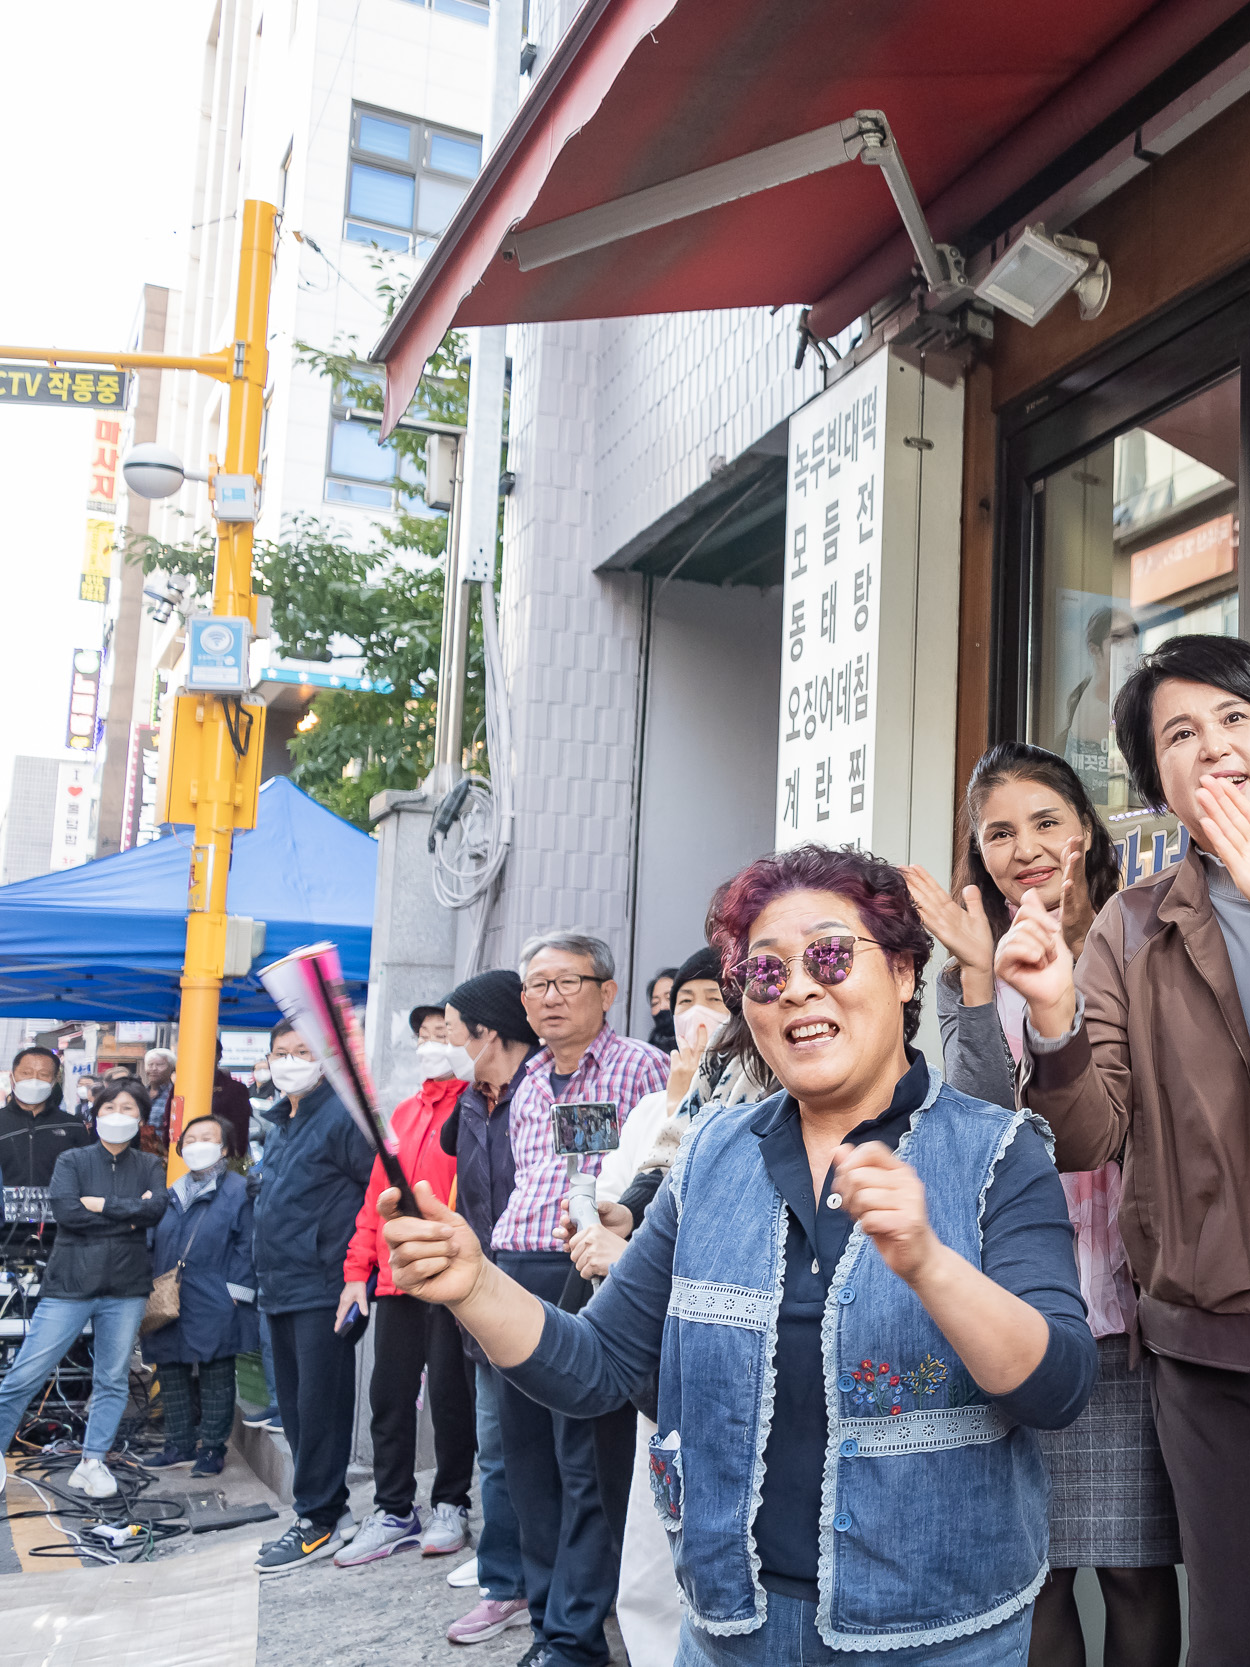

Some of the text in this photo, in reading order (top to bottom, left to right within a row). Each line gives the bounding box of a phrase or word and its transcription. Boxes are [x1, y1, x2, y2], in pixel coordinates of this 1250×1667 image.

[47, 371, 120, 404] 작동중
[91, 420, 121, 499] 마사지
[794, 384, 878, 498] 녹두빈대떡
[791, 474, 875, 581] 모듬전
[788, 562, 872, 663] 동태탕
[785, 652, 870, 743] 오징어데침
[783, 743, 867, 829] 계란찜
